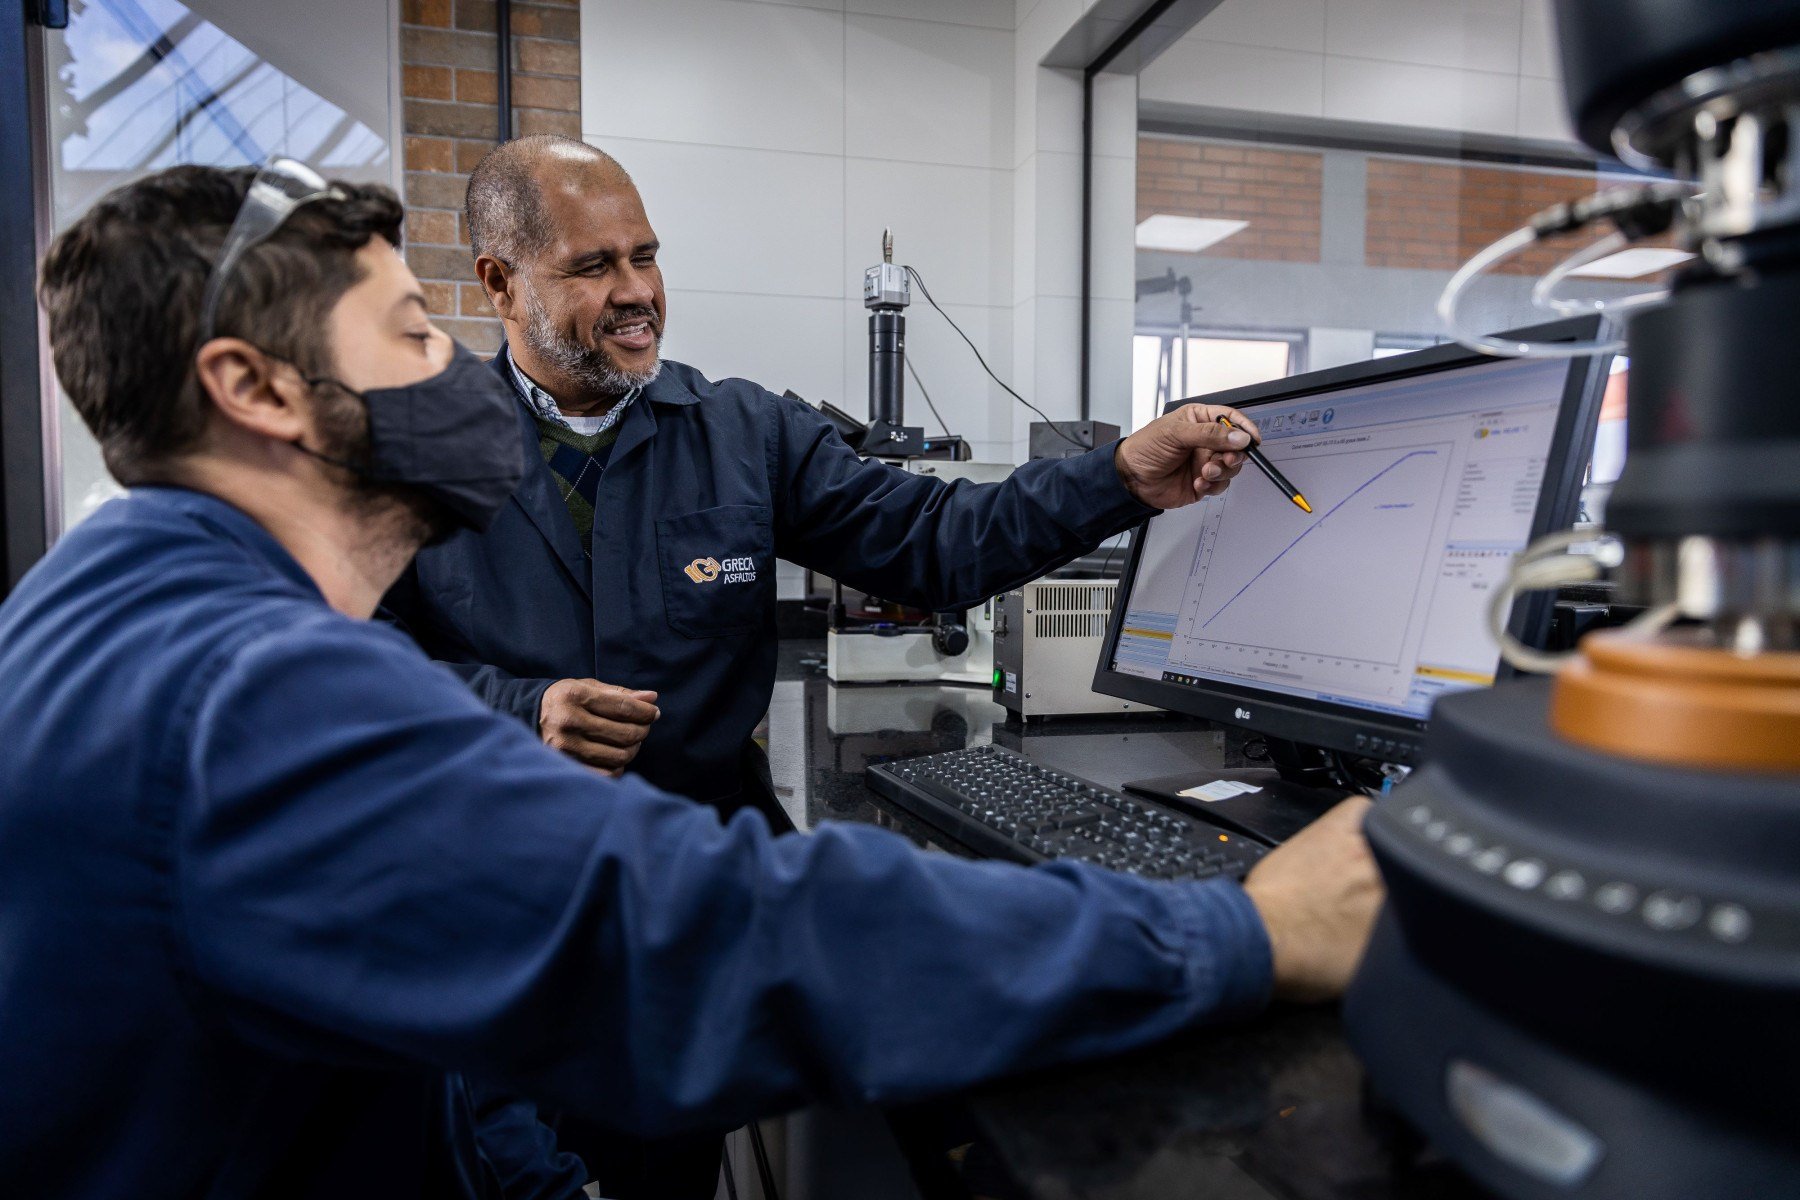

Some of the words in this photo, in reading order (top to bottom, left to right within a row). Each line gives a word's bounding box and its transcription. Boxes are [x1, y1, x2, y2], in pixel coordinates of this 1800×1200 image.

[721, 557, 755, 572] GRECA
[723, 572, 756, 584] ASFALTOS
[1241, 710, 1251, 720] LG
